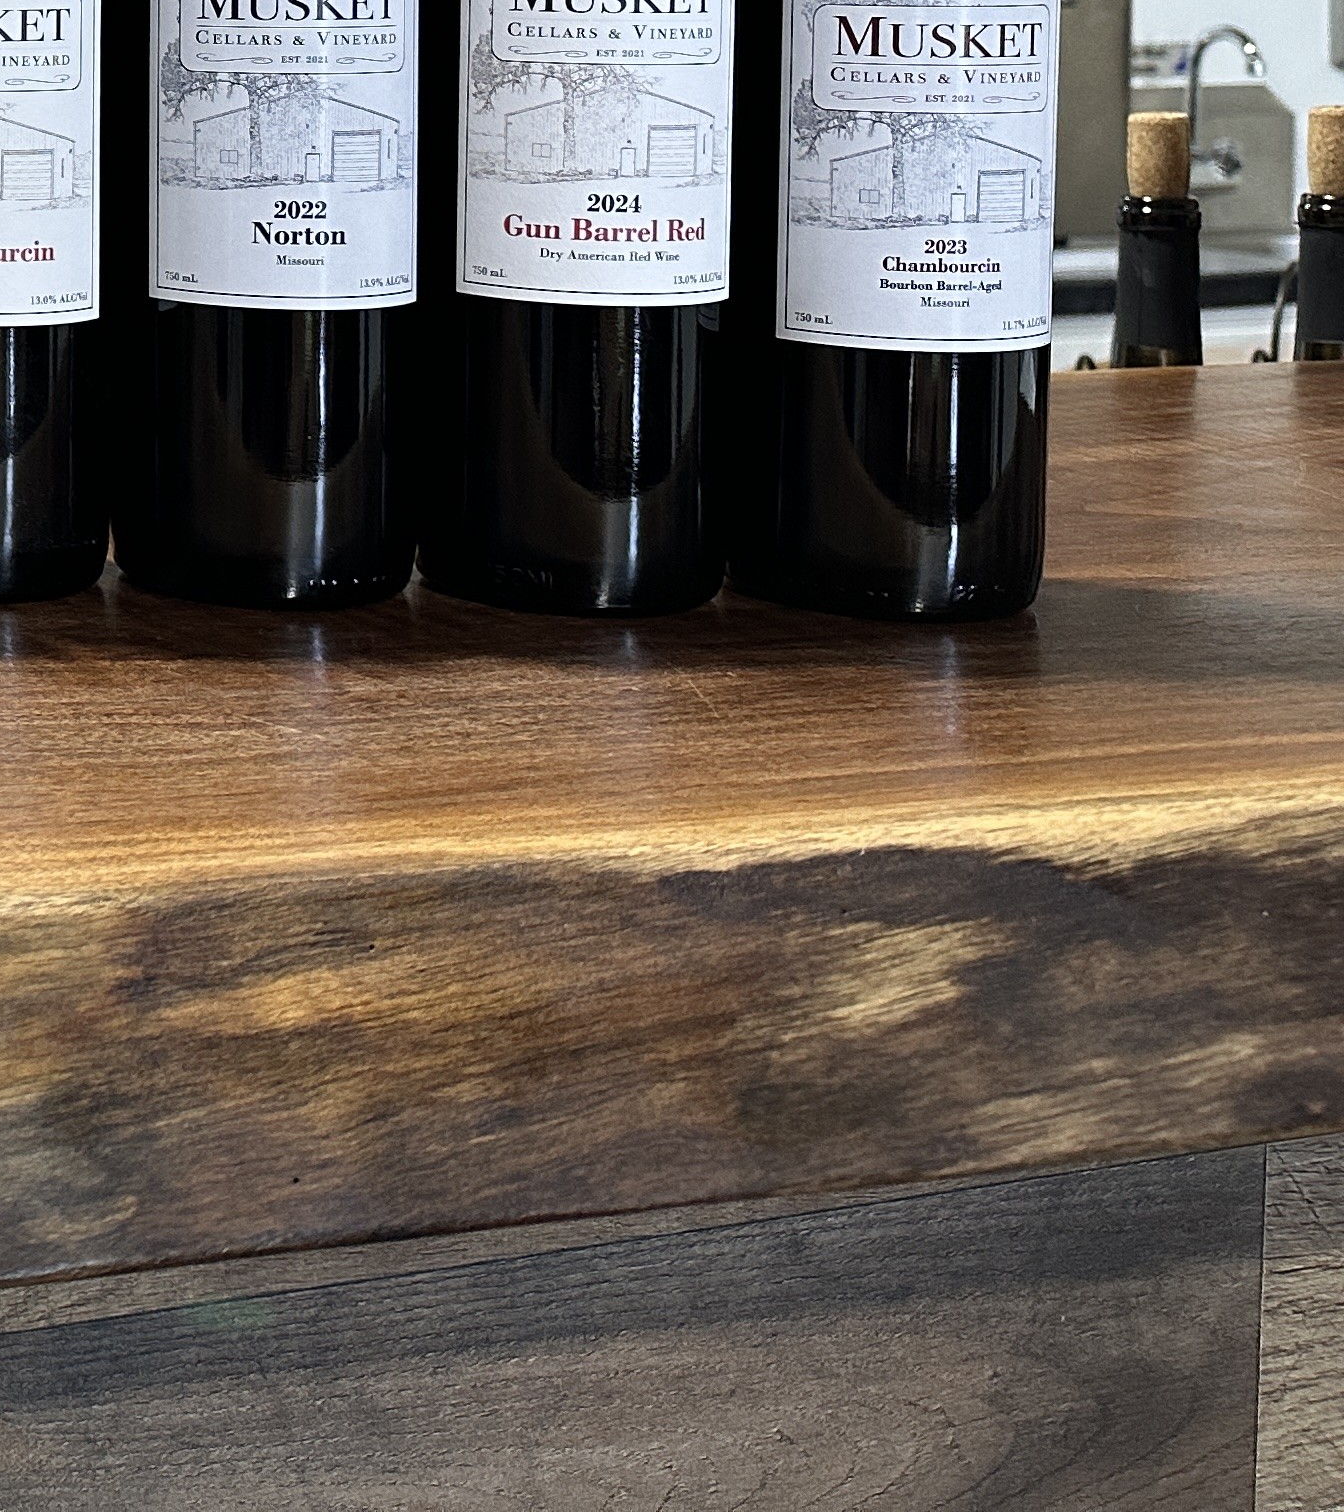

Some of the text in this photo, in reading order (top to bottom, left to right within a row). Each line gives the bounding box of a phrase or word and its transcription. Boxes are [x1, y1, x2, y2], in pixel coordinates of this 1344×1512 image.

[195, 30, 397, 46] CELLARS & VINEYARD
[507, 22, 714, 40] CELLARS & VINEYARD
[833, 15, 1043, 59] MUSKET
[305, 55, 328, 64] 2021
[622, 49, 645, 58] 2021
[830, 67, 1042, 84] CELLARS & VINEYARD
[274, 200, 327, 219] 2022
[587, 194, 642, 213] 2024
[251, 221, 346, 245] Norton
[503, 213, 705, 243] Gun Barrel Red
[539, 248, 679, 262] Dry American Red Wine
[924, 240, 967, 255] 2023
[276, 255, 324, 265] Missouri
[882, 256, 1001, 273] Chambourcin
[165, 271, 180, 281] 750
[472, 265, 487, 276] 750
[880, 279, 1002, 293] Bourbon Barrel-Aged
[921, 297, 970, 307] Missouri
[794, 312, 811, 322] 750
